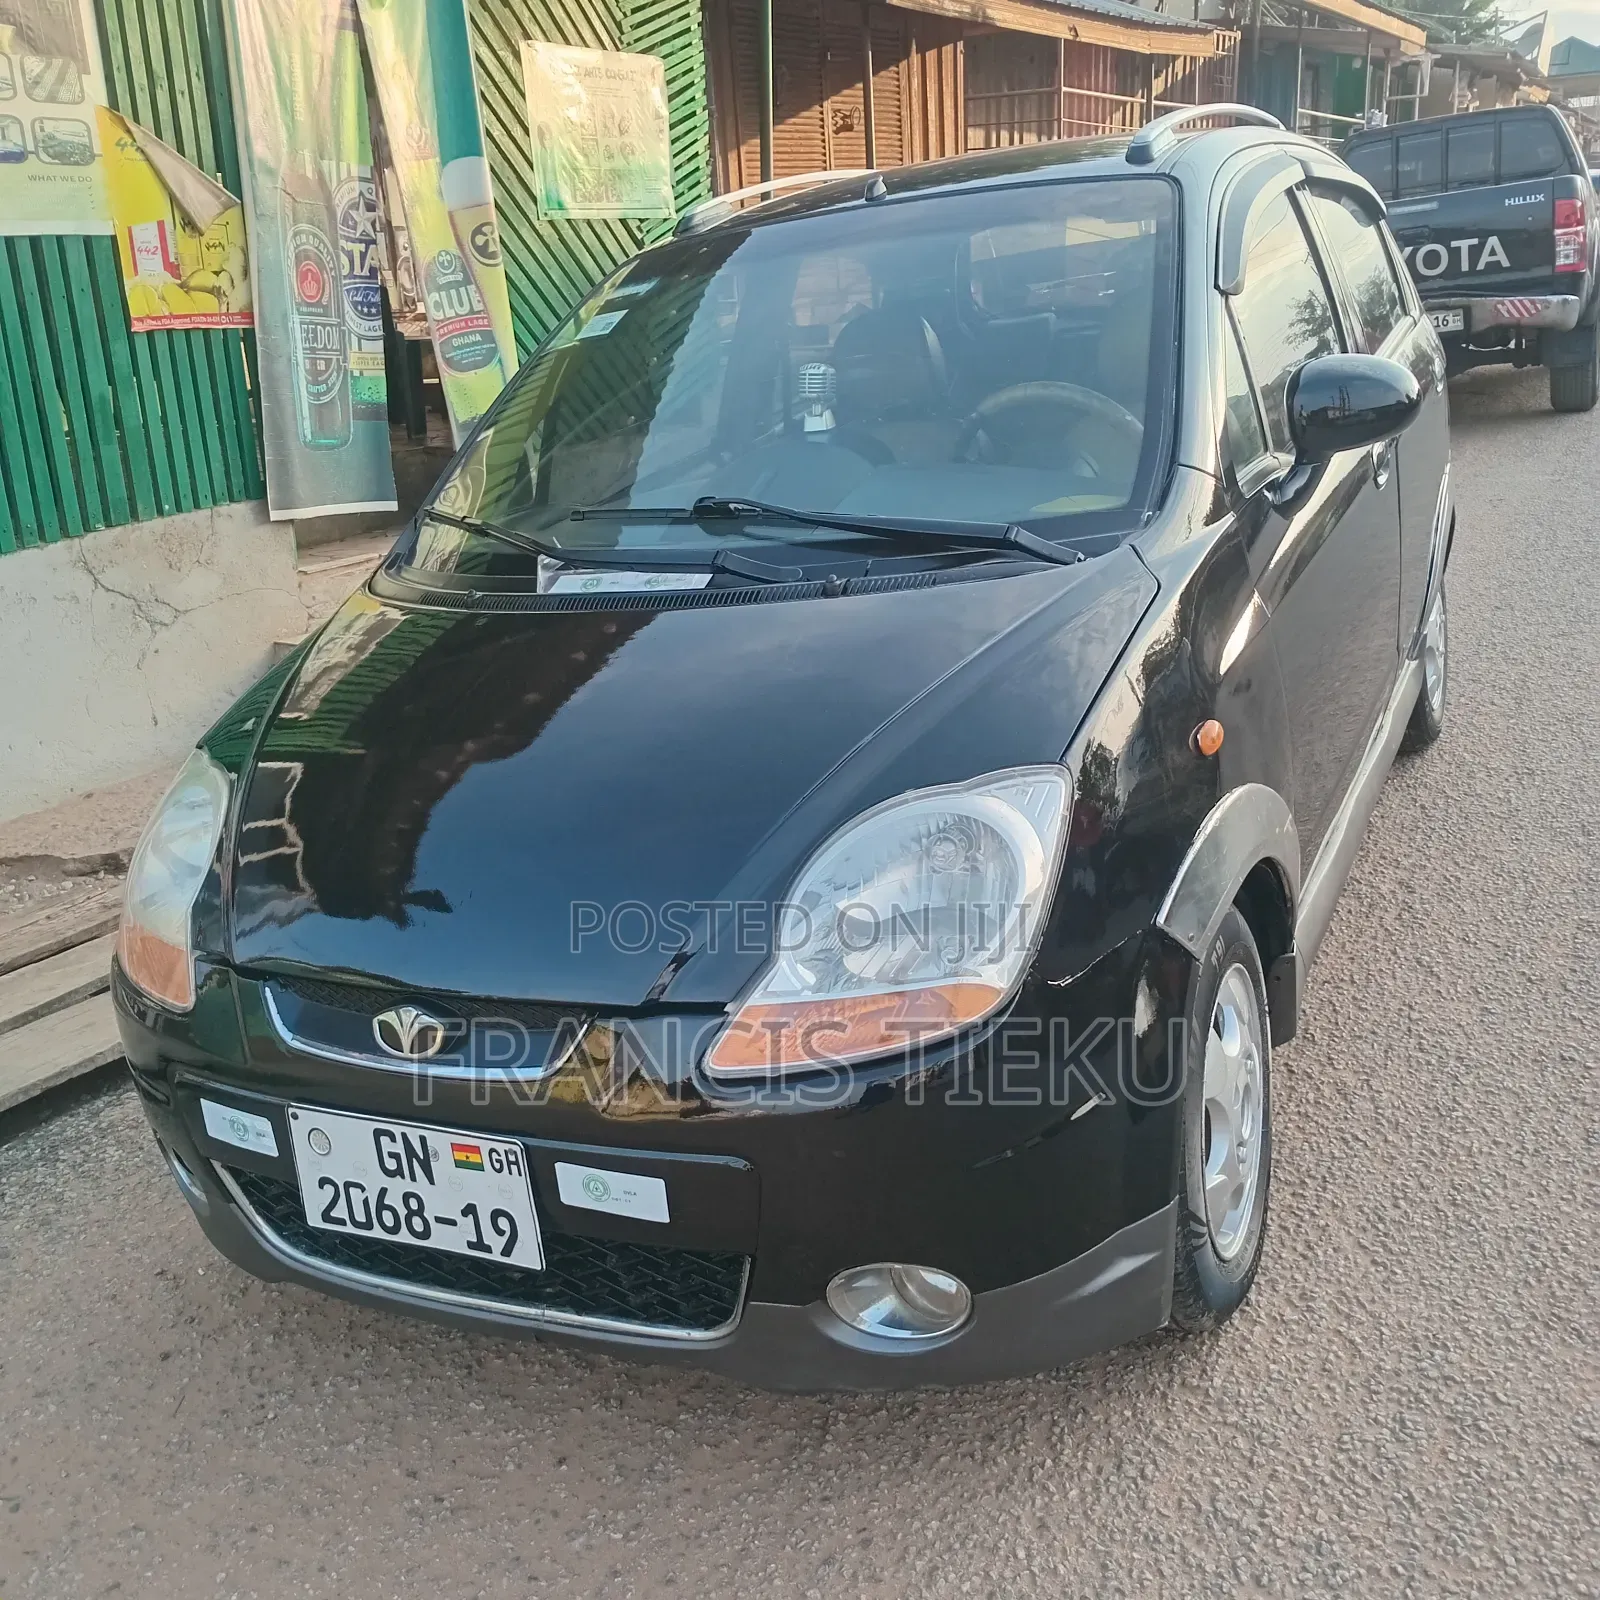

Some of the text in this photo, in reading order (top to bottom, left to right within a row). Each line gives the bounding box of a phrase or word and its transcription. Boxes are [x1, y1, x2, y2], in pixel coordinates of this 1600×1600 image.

[28, 174, 93, 183] WHAT WE DO
[1504, 193, 1545, 206] HILUX
[137, 245, 159, 256] 442
[1433, 314, 1450, 328] 16
[301, 324, 340, 350] EEDOM
[436, 321, 466, 338] PREMIUM
[452, 333, 482, 347] GHANA
[373, 1127, 436, 1186] GN
[488, 1147, 523, 1177] GH
[318, 1175, 519, 1258] 2068-19
